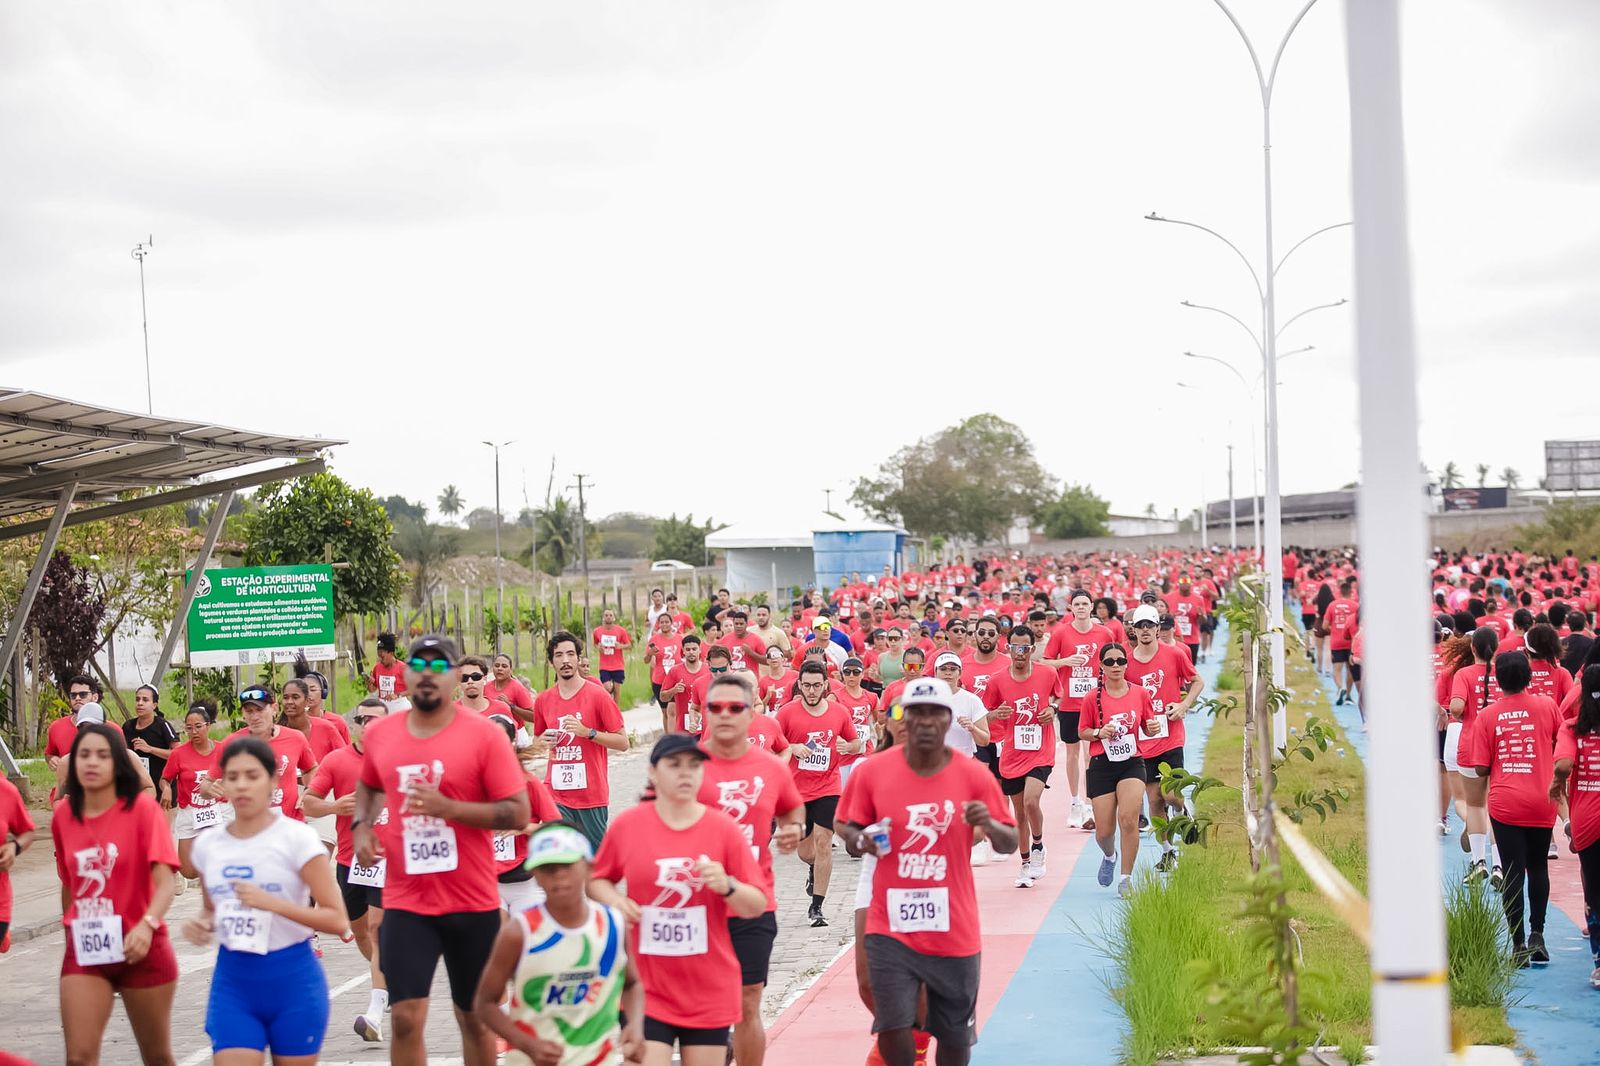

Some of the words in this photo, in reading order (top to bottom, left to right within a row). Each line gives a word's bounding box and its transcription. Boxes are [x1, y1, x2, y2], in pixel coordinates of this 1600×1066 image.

[222, 574, 262, 587] ESTAÇÃO
[264, 573, 330, 584] EXPERIMENTAL
[236, 586, 248, 596] DE
[250, 584, 316, 596] HORTICULTURA
[296, 612, 324, 620] orgânicos,
[242, 622, 261, 630] ajudam
[266, 620, 301, 628] compreender
[206, 632, 232, 640] processos
[263, 628, 288, 638] produção
[296, 626, 324, 634] alimentos.
[1498, 710, 1529, 720] ATLETA
[1020, 734, 1034, 744] 191
[556, 752, 582, 760] UEFS
[562, 772, 573, 783] 23
[196, 810, 216, 822] 5295
[410, 841, 450, 860] 5048
[898, 853, 946, 866] VOLTA
[898, 864, 946, 881] UEFS
[900, 902, 936, 920] 5219
[652, 923, 692, 942] 5061
